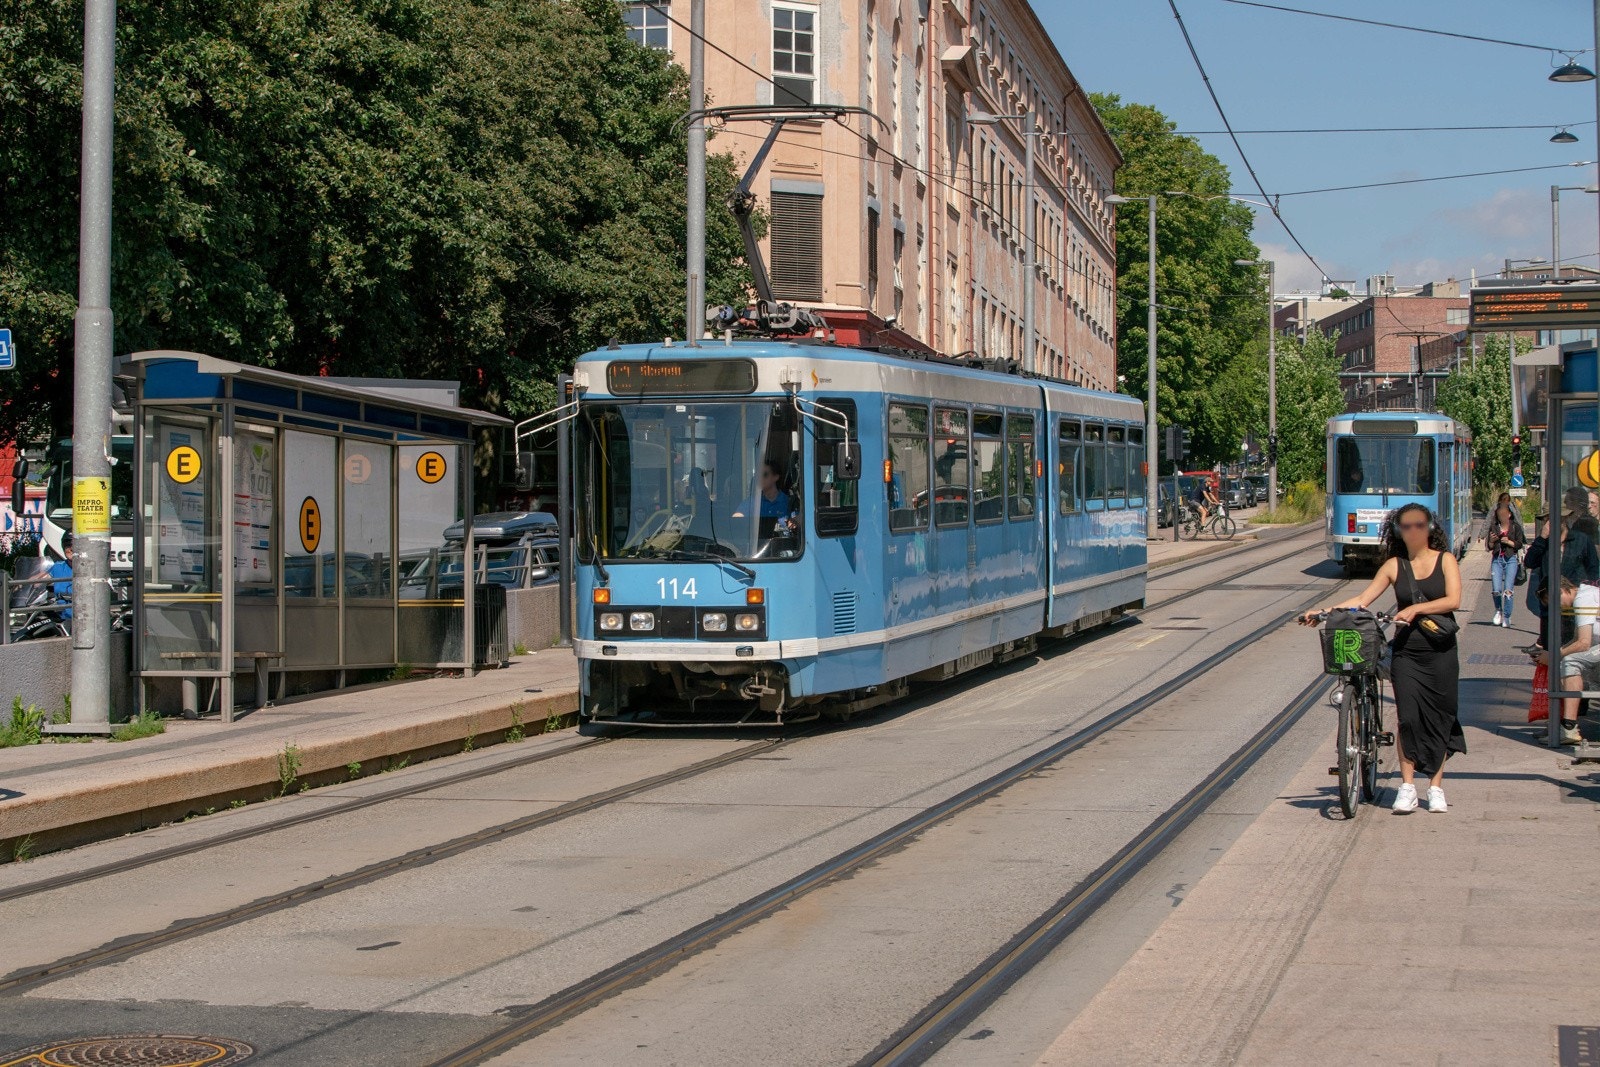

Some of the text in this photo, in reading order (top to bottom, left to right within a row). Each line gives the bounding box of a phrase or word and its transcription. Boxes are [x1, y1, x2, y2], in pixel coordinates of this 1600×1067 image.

[177, 453, 191, 476] E
[425, 458, 438, 477] E
[306, 509, 315, 540] E
[657, 577, 698, 600] 114
[1334, 629, 1365, 664] R
